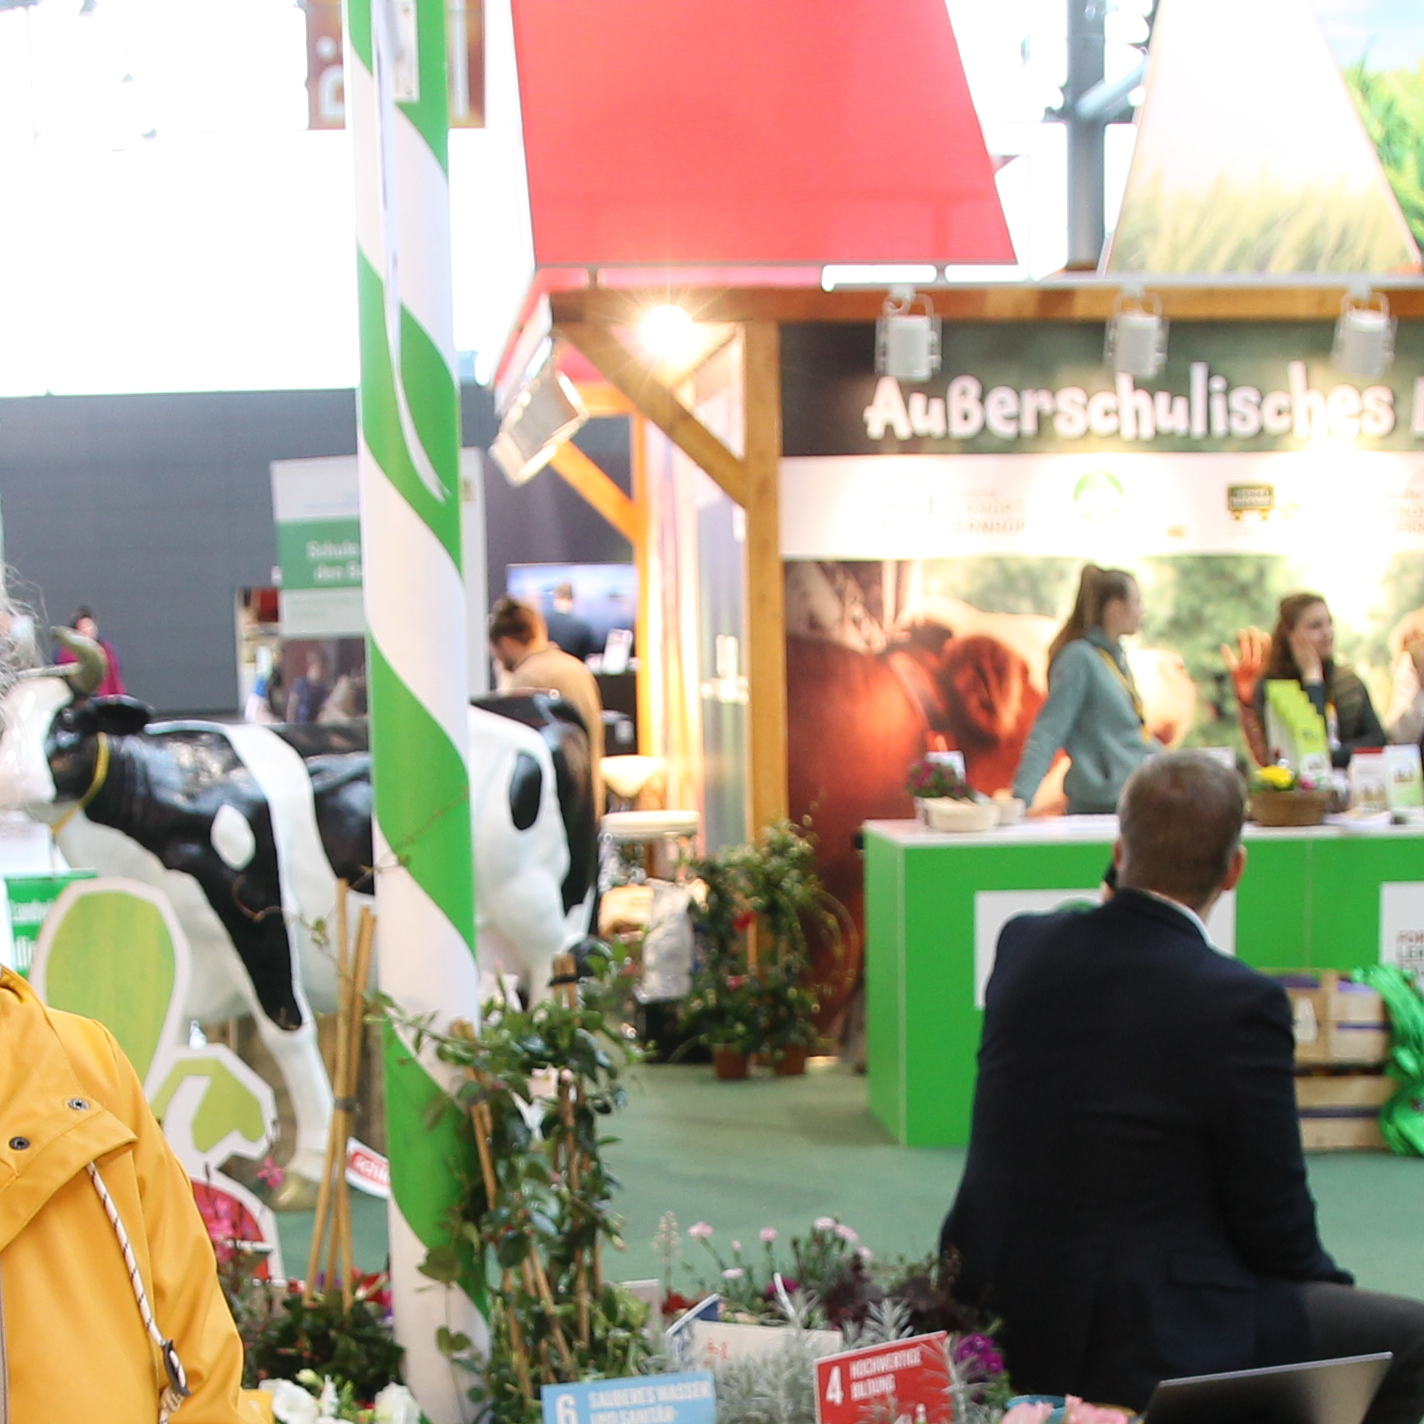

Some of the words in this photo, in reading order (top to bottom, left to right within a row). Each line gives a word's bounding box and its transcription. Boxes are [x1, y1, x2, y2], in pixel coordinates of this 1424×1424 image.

[864, 360, 1396, 441] Außerschulisches
[588, 1385, 656, 1410] SAUBERES
[656, 1380, 712, 1403] WASSER
[825, 1364, 845, 1406] 4
[850, 1372, 896, 1401] BILDUNG
